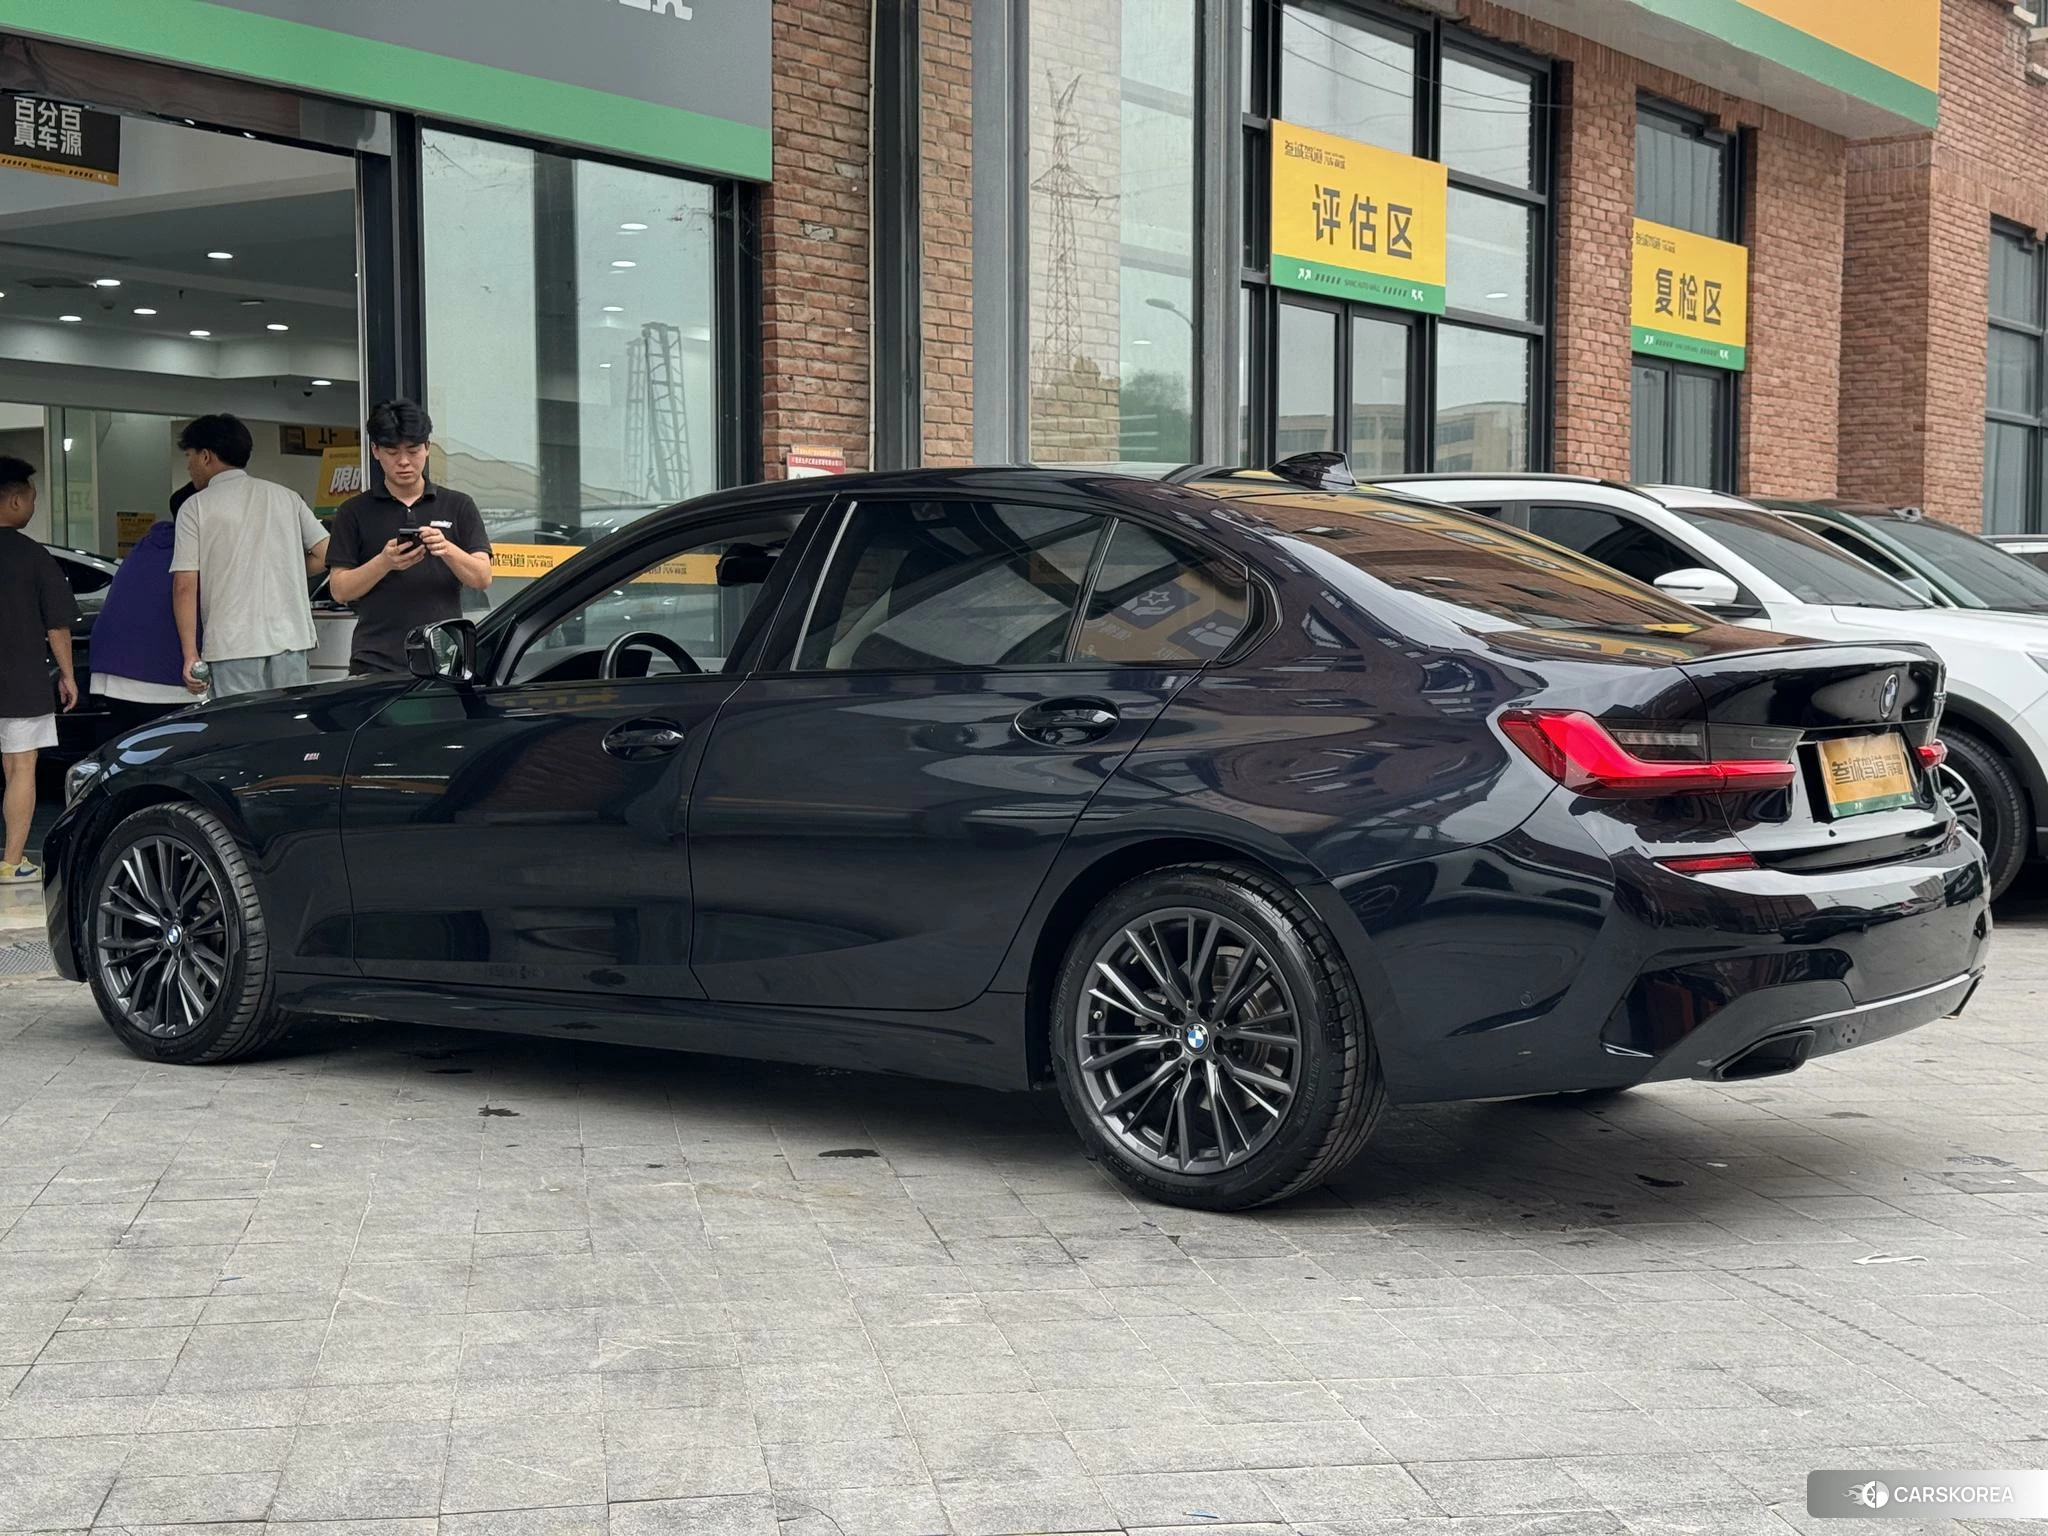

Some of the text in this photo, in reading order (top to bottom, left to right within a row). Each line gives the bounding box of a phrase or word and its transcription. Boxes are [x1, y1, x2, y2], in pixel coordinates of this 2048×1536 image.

[14, 96, 82, 131] 百分百
[14, 121, 82, 156] 真车源
[1312, 184, 1412, 259] 评估区
[1655, 268, 1722, 326] 复检区
